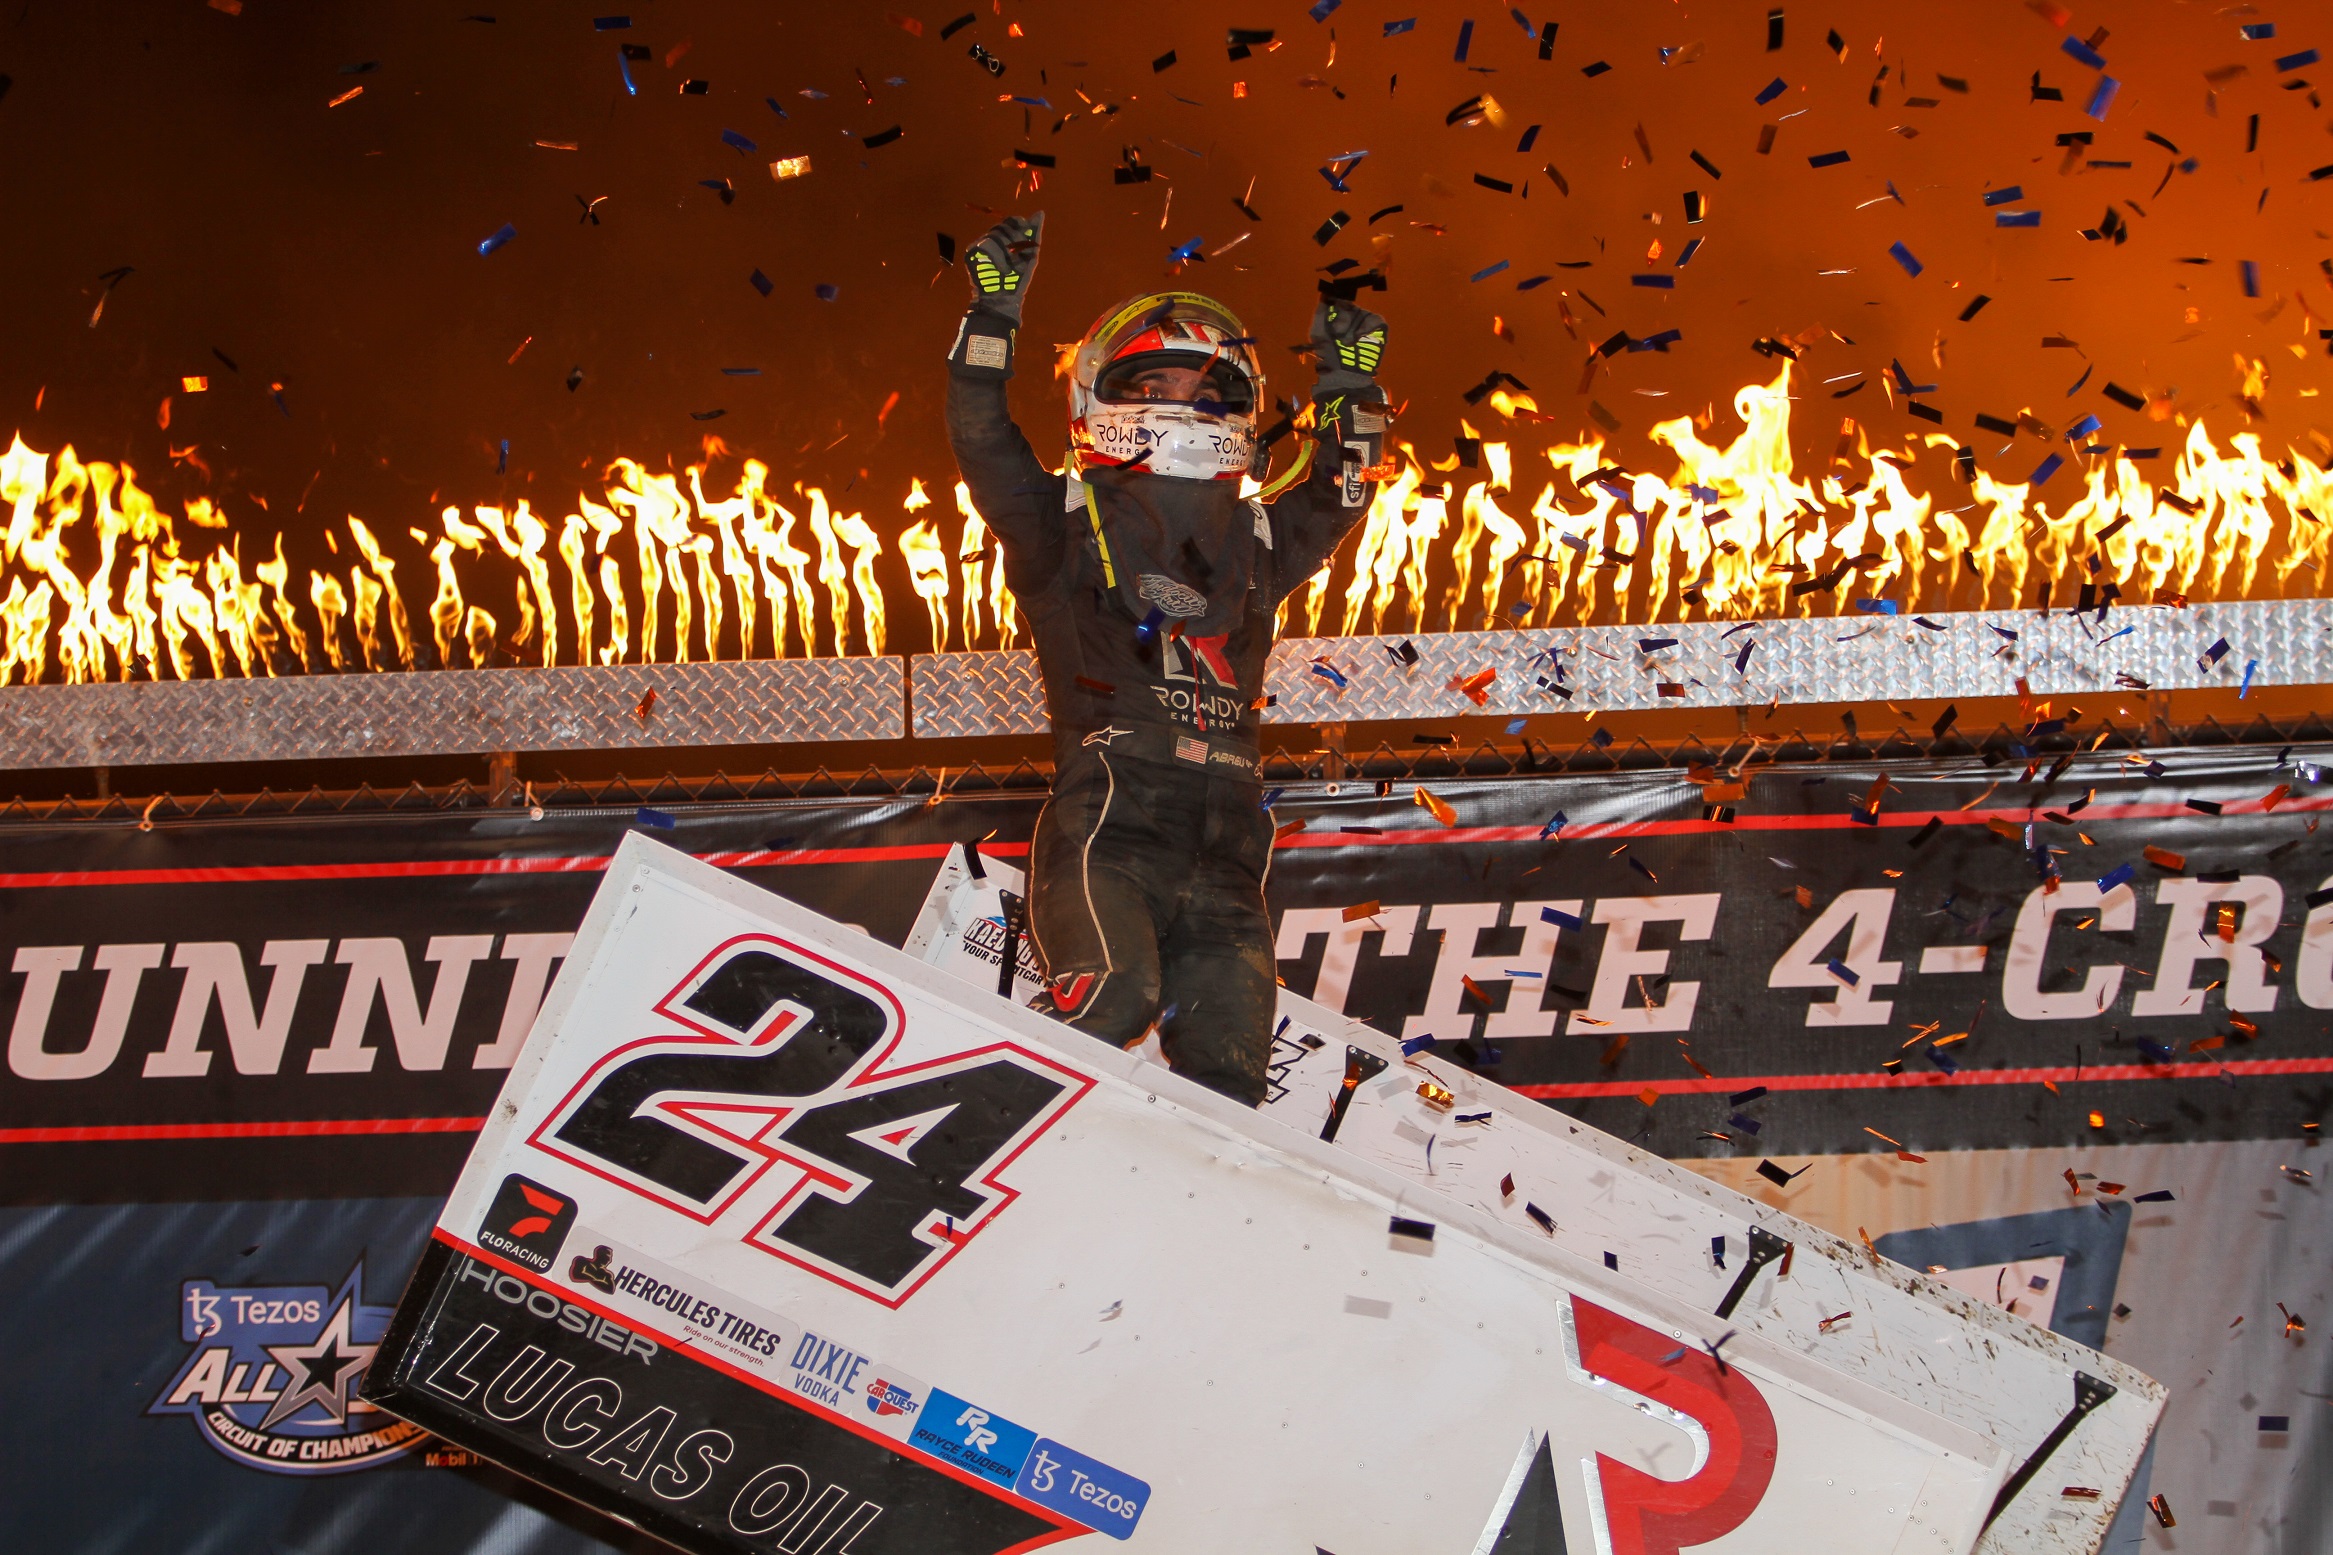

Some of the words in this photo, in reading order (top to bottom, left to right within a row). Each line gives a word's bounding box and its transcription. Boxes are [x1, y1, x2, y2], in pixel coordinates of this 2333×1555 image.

[1097, 424, 1169, 447] ROWDY
[1105, 446, 1142, 456] ENERG
[1150, 685, 1245, 721] ROWDY
[1209, 751, 1245, 768] ABREU
[1276, 892, 1722, 1039] THE
[525, 933, 1100, 1310] 24
[480, 1231, 549, 1269] FLORACING
[230, 1295, 320, 1324] Tezos
[460, 1259, 659, 1365] HOOSIER
[614, 1265, 720, 1329] HERCULES
[717, 1312, 782, 1356] TIRES
[683, 1325, 702, 1338] Ride
[703, 1335, 714, 1343] on
[714, 1340, 729, 1350] our
[729, 1346, 765, 1367] strength.
[790, 1332, 870, 1395] DIXIE
[168, 1349, 281, 1404] ALL
[794, 1373, 840, 1407] VODKA
[866, 1383, 919, 1413] CARQUEST
[208, 1411, 267, 1452] CIRCUIT
[267, 1440, 298, 1459] OF
[426, 1323, 735, 1500] LUCAS
[729, 1464, 883, 1555] OIL
[915, 1429, 962, 1455] RAYCE
[961, 1450, 1017, 1479] RUDEEN
[426, 1453, 466, 1467] Mobil
[936, 1450, 984, 1475] FOUNDATION
[1068, 1469, 1137, 1520] Tezos
